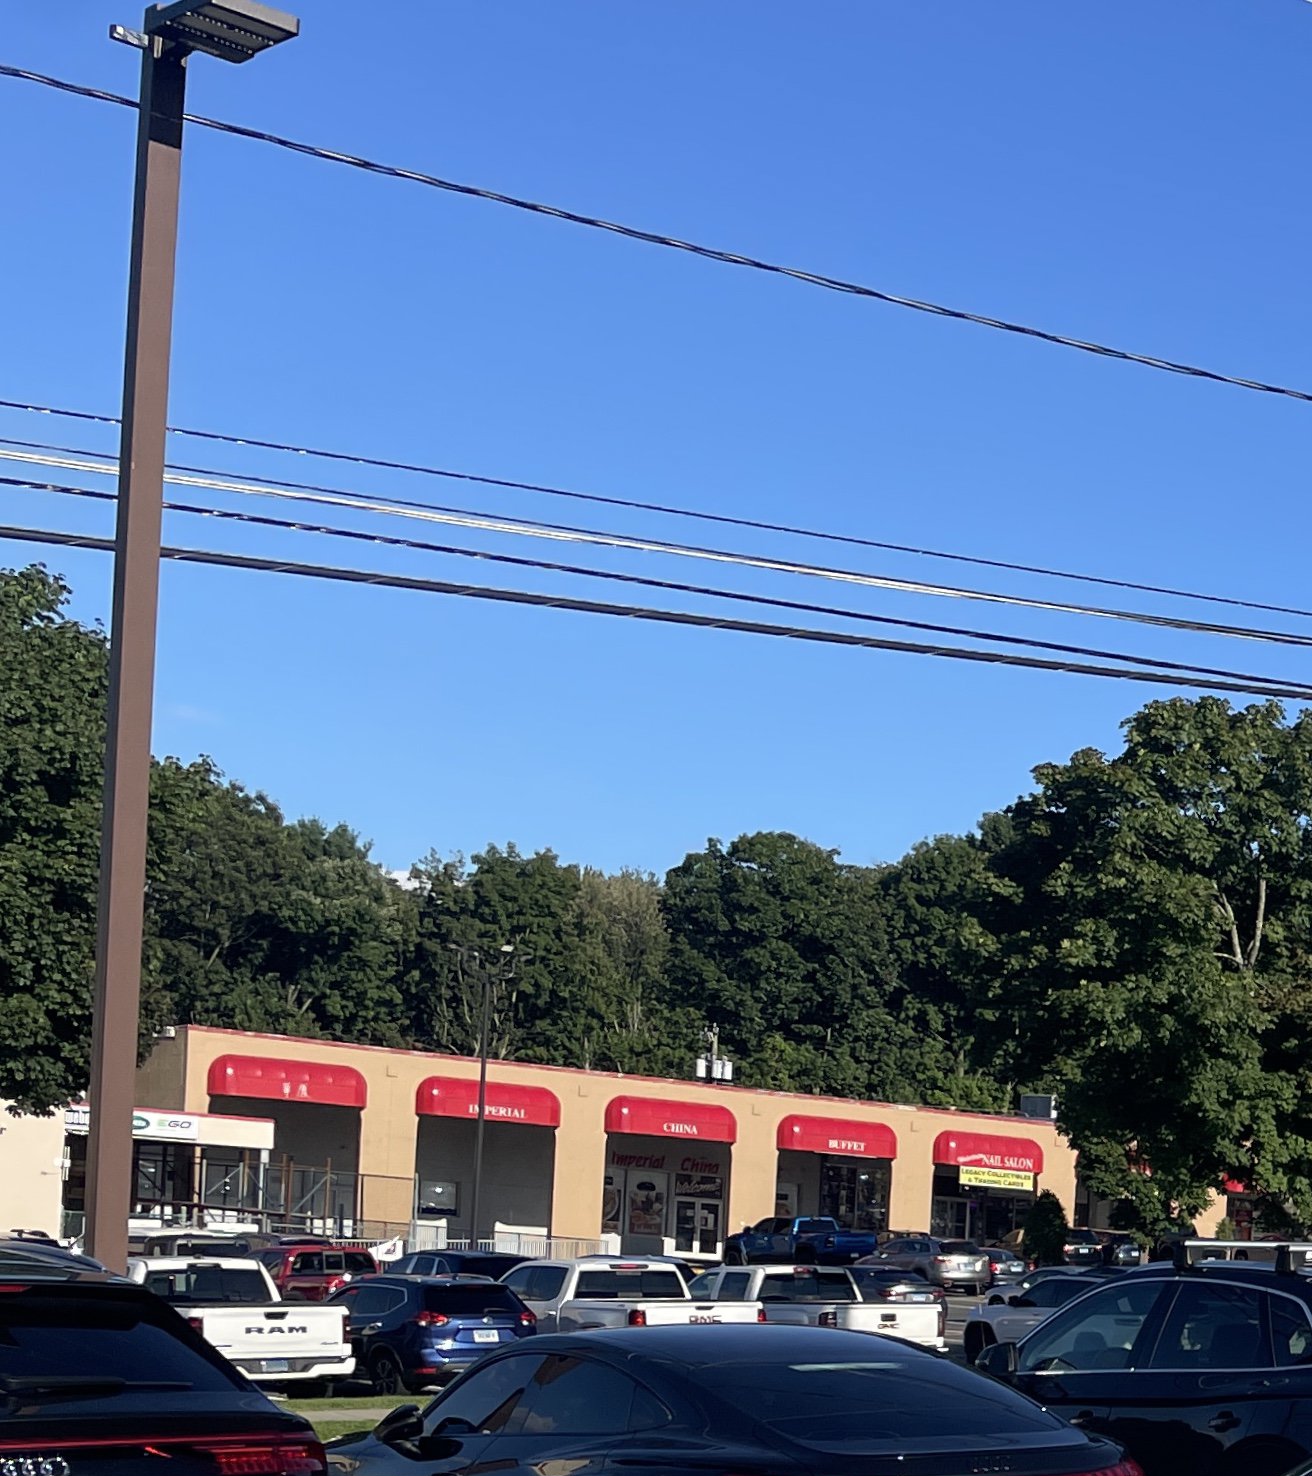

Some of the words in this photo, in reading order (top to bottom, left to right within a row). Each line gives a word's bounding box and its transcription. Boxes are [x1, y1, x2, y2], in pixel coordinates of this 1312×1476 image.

[157, 1118, 192, 1129] EGO
[663, 1122, 698, 1135] CHINA
[828, 1139, 867, 1151] BUFFET
[611, 1151, 666, 1169] Imperial
[680, 1157, 720, 1175] China
[981, 1154, 1003, 1167] NAIL
[1004, 1156, 1034, 1169] SALON
[245, 1326, 308, 1334] RAM
